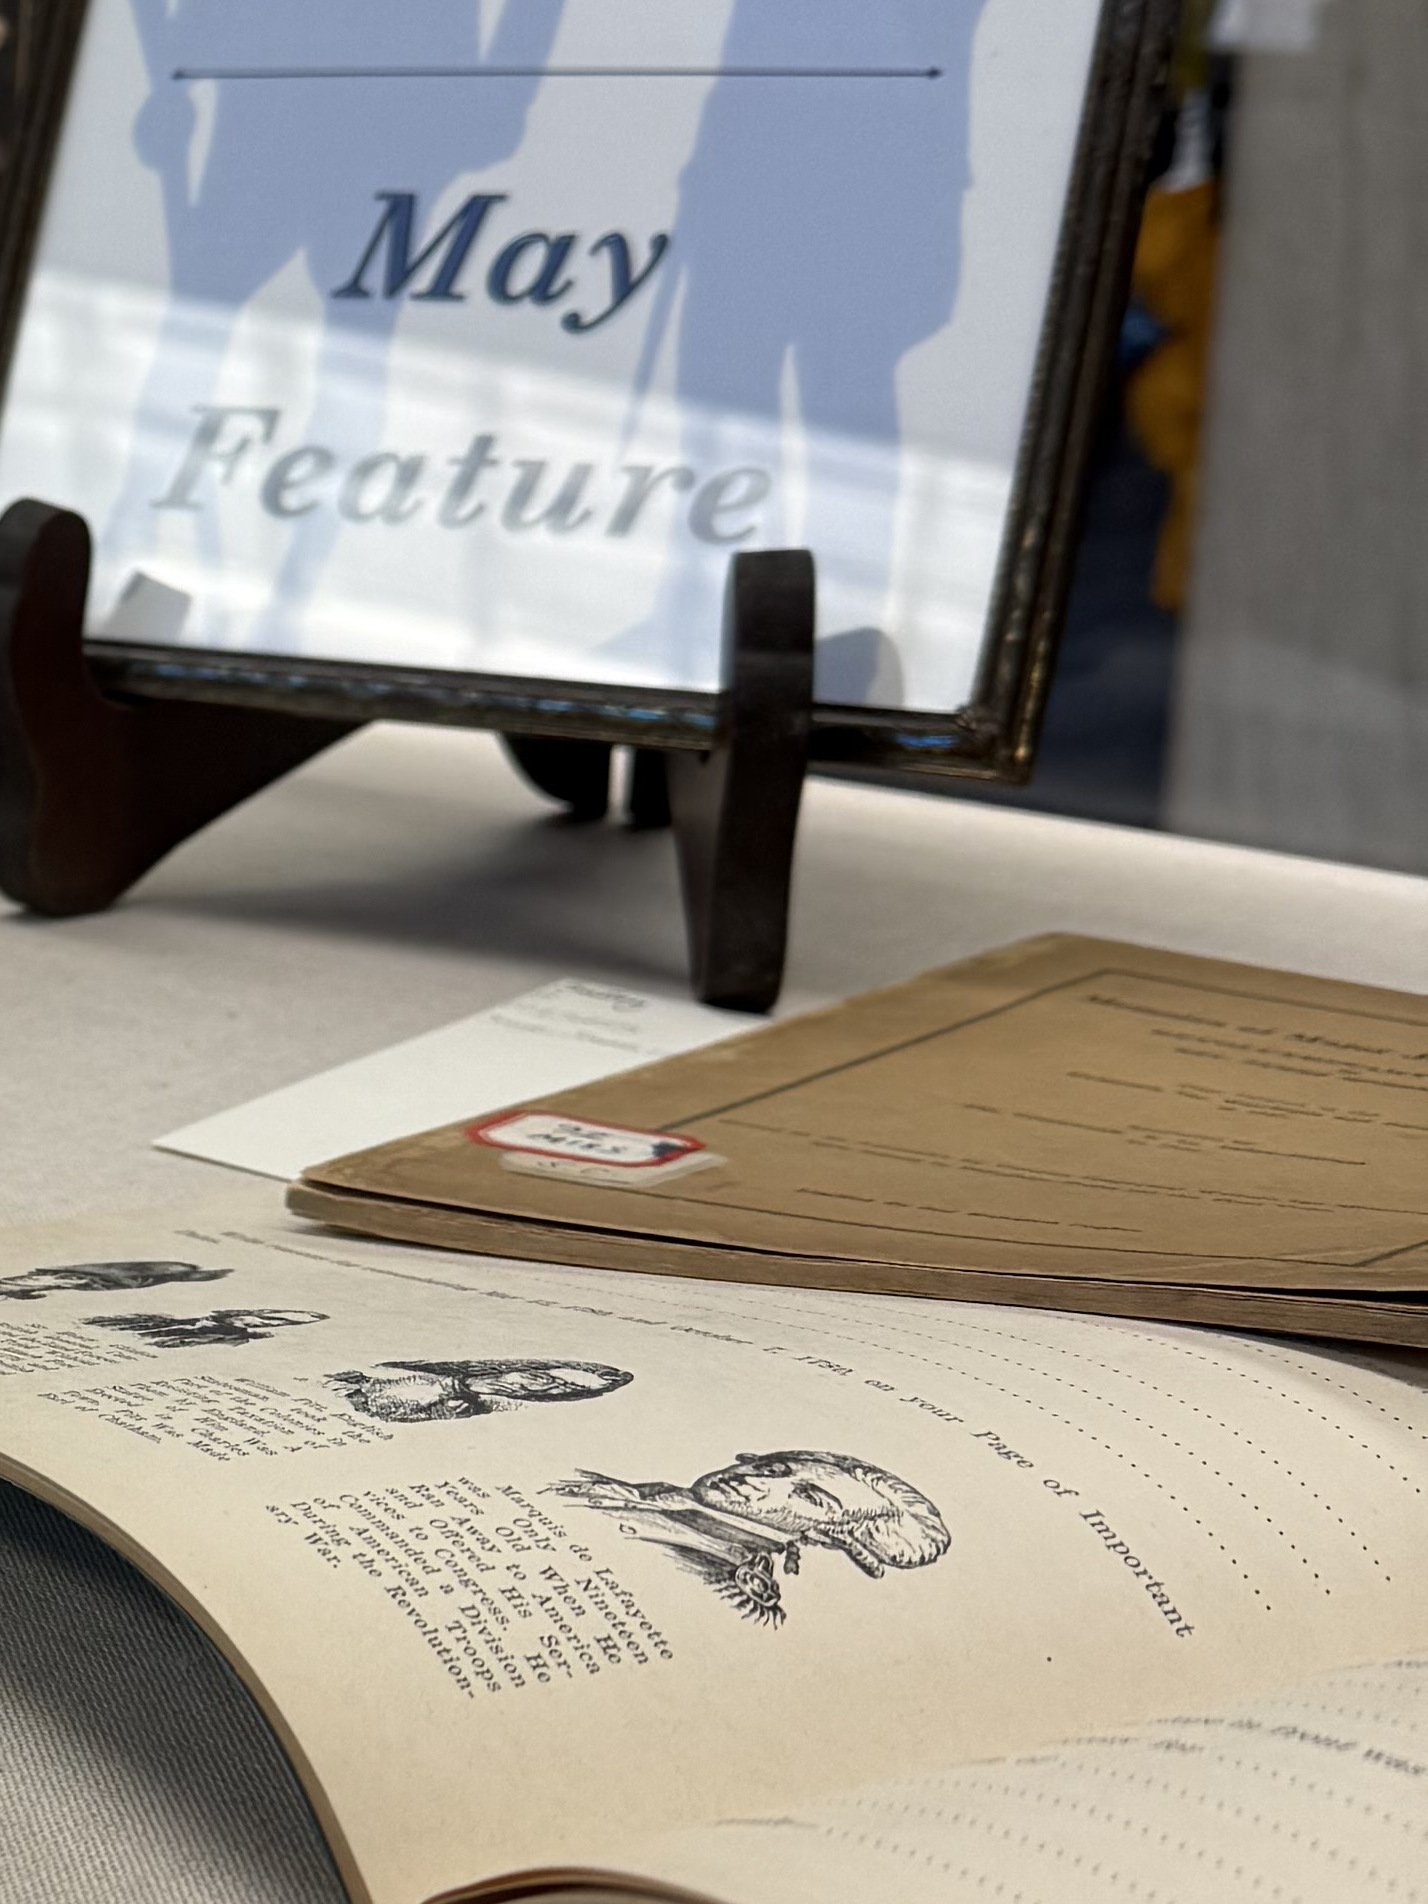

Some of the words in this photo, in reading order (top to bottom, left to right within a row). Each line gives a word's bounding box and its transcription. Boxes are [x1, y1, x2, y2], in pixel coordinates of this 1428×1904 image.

[334, 190, 673, 330] May
[155, 404, 773, 544] Feature
[265, 1505, 299, 1526] ary
[305, 1532, 341, 1568] War.
[291, 1500, 351, 1547] During
[353, 1553, 382, 1578] the
[385, 1584, 474, 1699] Revolution-
[313, 1496, 340, 1511] of
[350, 1525, 429, 1599] American
[445, 1620, 501, 1695] Troops
[339, 1494, 442, 1575] Commanded
[440, 1584, 454, 1595] a
[459, 1604, 525, 1689] Division
[363, 1491, 406, 1522] vices
[409, 1522, 429, 1542] to
[434, 1547, 510, 1631] Congress.
[524, 1653, 550, 1684] He
[385, 1487, 423, 1510] and
[429, 1518, 496, 1574] Offered
[499, 1586, 533, 1620] His
[539, 1635, 573, 1679] Ser-
[409, 1483, 445, 1510] Ran
[452, 1515, 502, 1555] Away
[506, 1562, 527, 1582] to
[532, 1591, 600, 1676] America
[435, 1480, 484, 1517] Years
[495, 1526, 531, 1553] Old
[539, 1565, 585, 1618] When
[594, 1634, 621, 1665] He
[458, 1477, 492, 1499] was
[513, 1517, 557, 1553] Only
[575, 1576, 649, 1666] Nineteen
[496, 1485, 567, 1539] Marquis
[569, 1543, 593, 1563] de
[593, 1567, 674, 1661] Lafayette
[900, 1396, 964, 1424] your
[969, 1430, 1034, 1470] Page
[1043, 1478, 1080, 1497] of
[1080, 1509, 1196, 1639] Important
